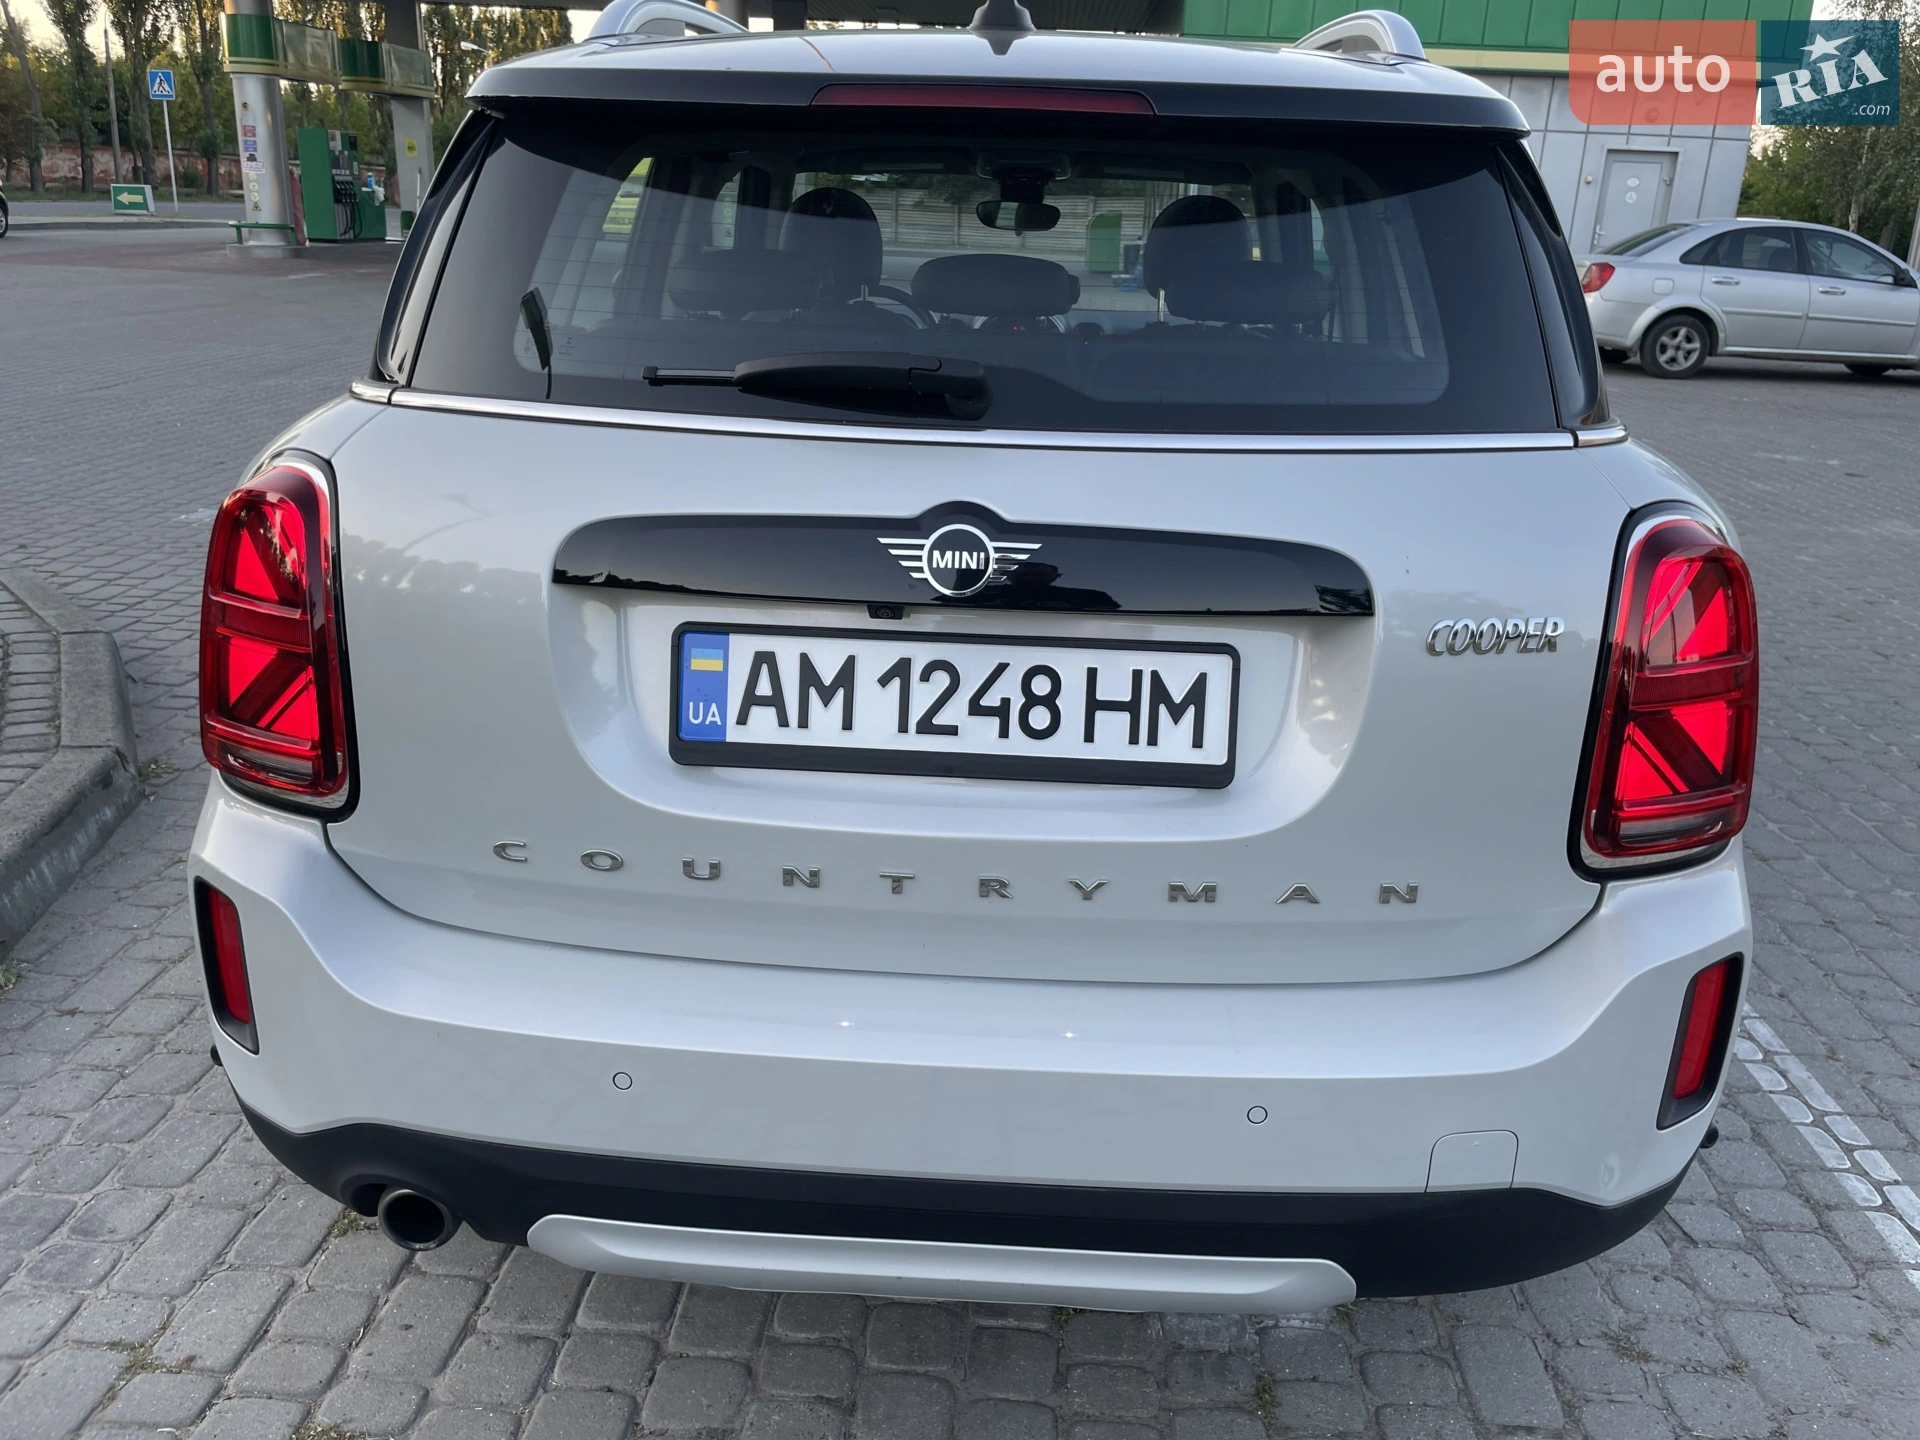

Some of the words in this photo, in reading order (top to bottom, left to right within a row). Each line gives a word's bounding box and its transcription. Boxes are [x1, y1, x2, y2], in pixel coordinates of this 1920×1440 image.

[932, 549, 985, 570] MINI
[1425, 616, 1565, 656] COOPER
[688, 702, 722, 726] UA
[735, 650, 856, 731] AM
[876, 657, 1063, 741] 1248
[1083, 666, 1208, 749] HM
[492, 839, 1419, 905] COUNTRYMAN
